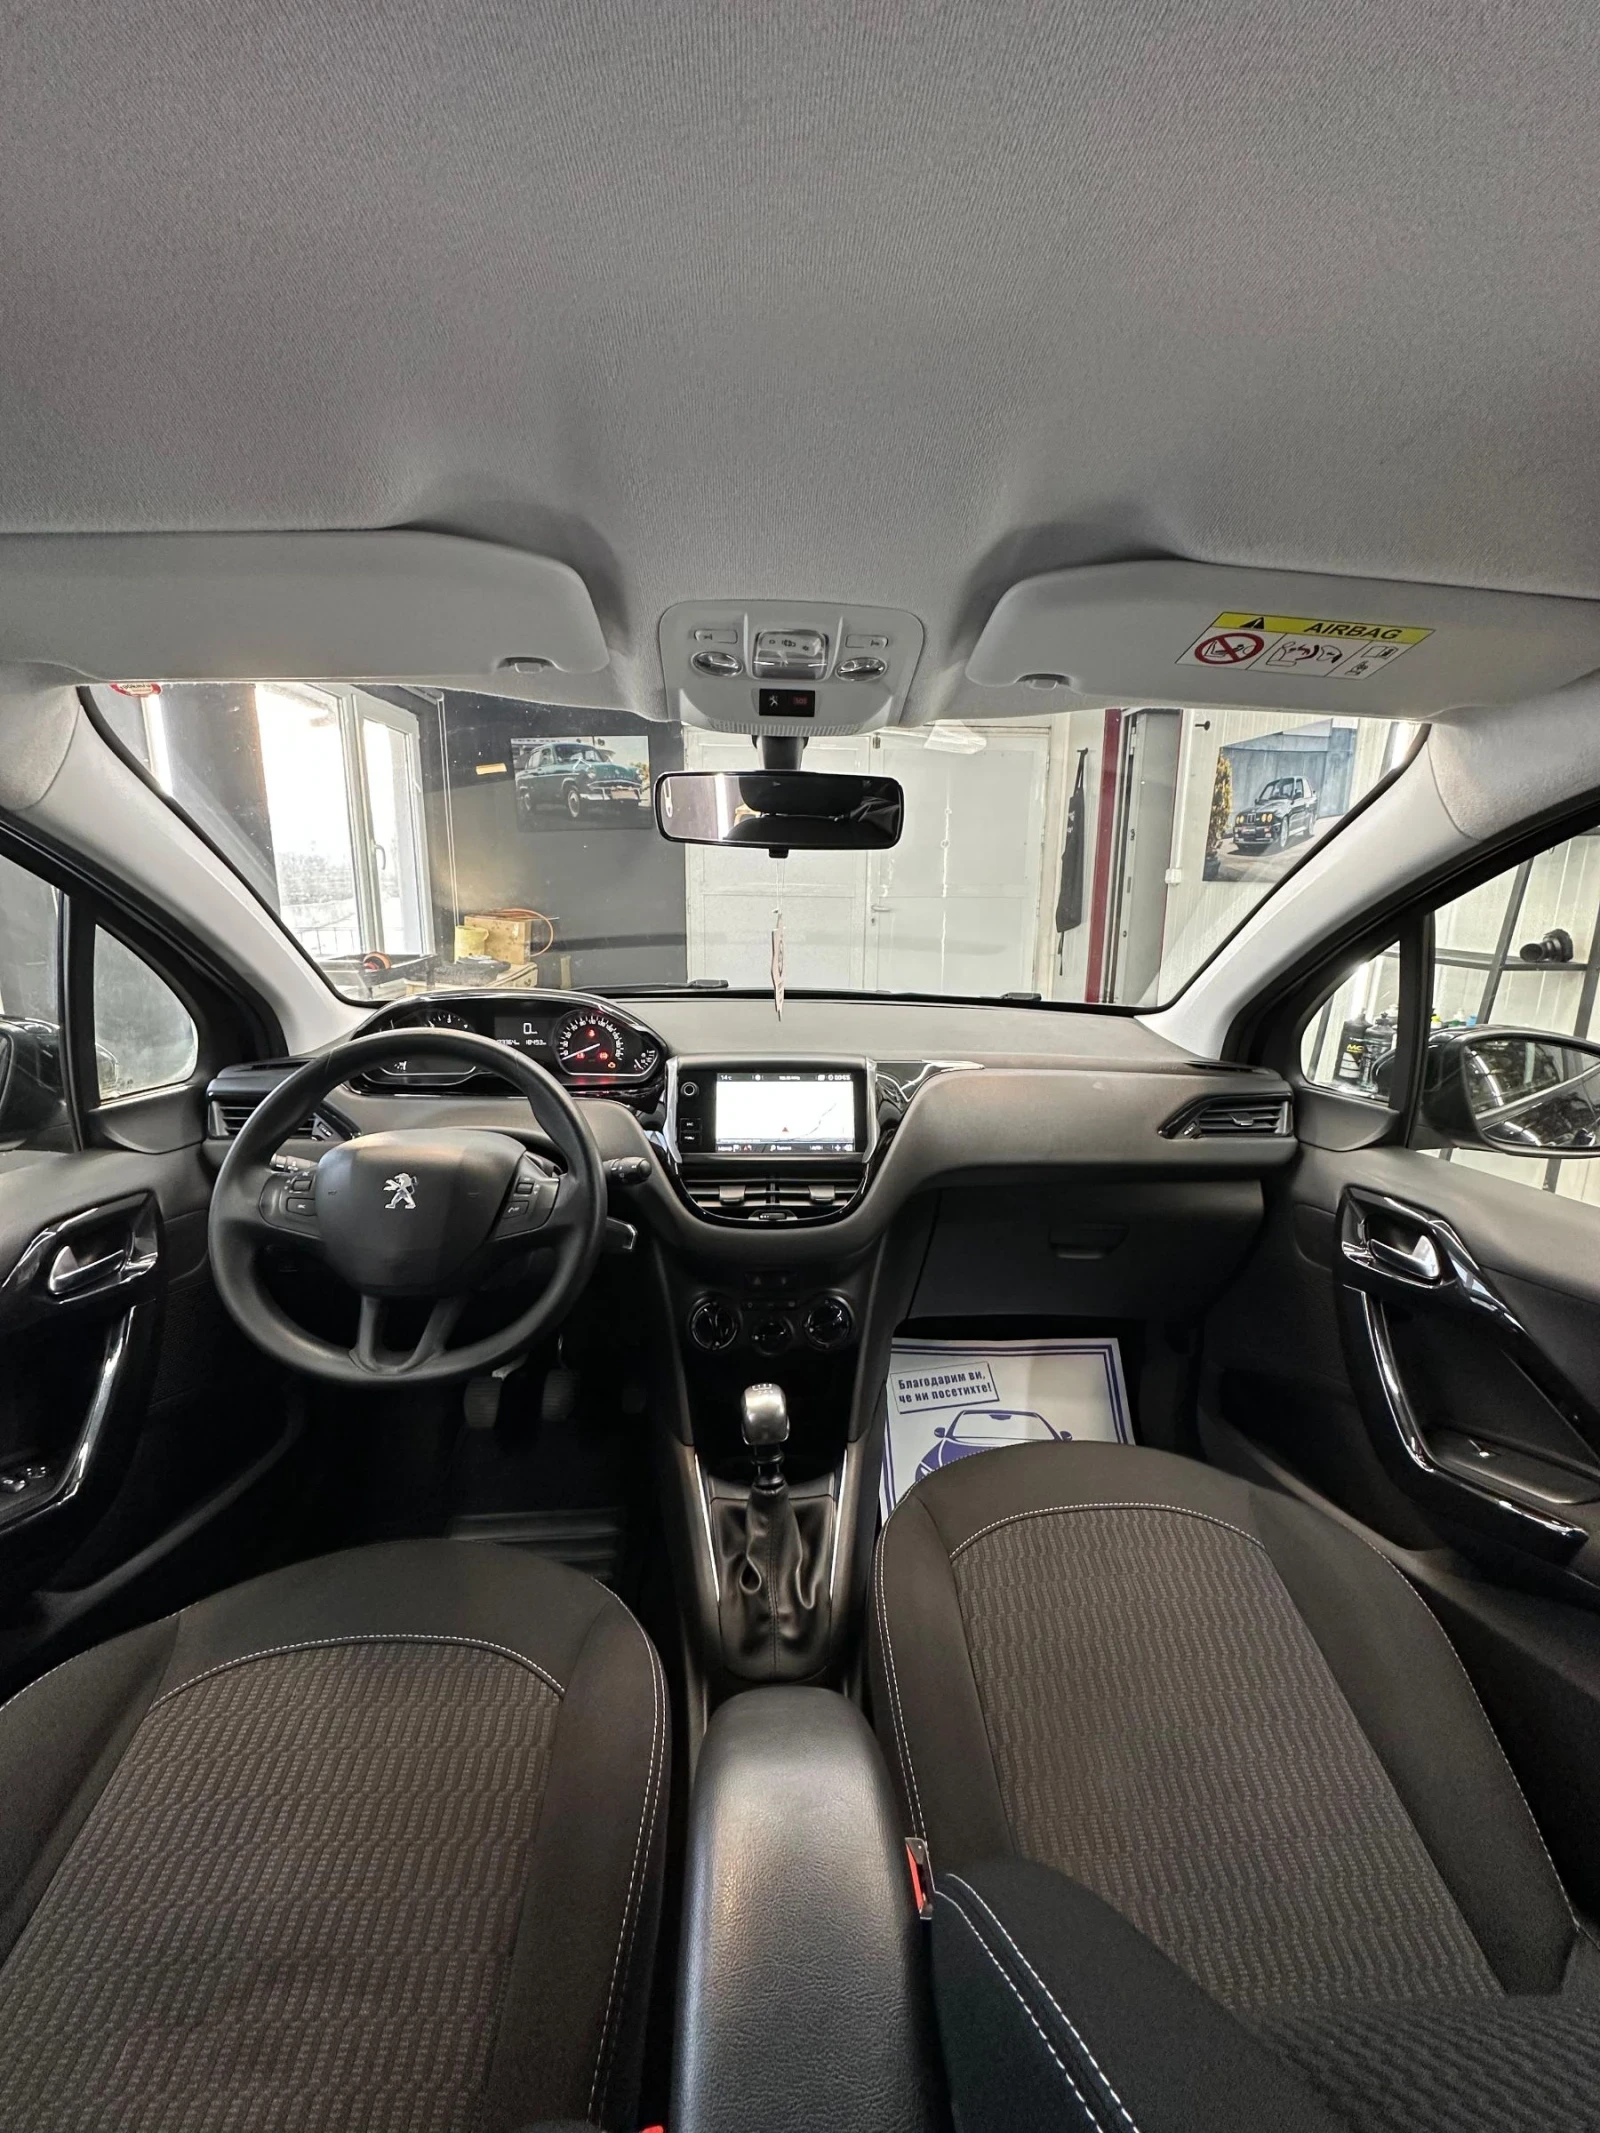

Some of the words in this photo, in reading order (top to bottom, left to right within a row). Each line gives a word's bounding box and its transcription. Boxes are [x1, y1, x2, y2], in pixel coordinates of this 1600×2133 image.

[1304, 622, 1403, 640] AIRBAG
[898, 1373, 966, 1389] Благодарим
[968, 1371, 986, 1380] ви,
[899, 1393, 912, 1403] че
[914, 1392, 929, 1402] ни
[931, 1382, 992, 1400] посетихте!
